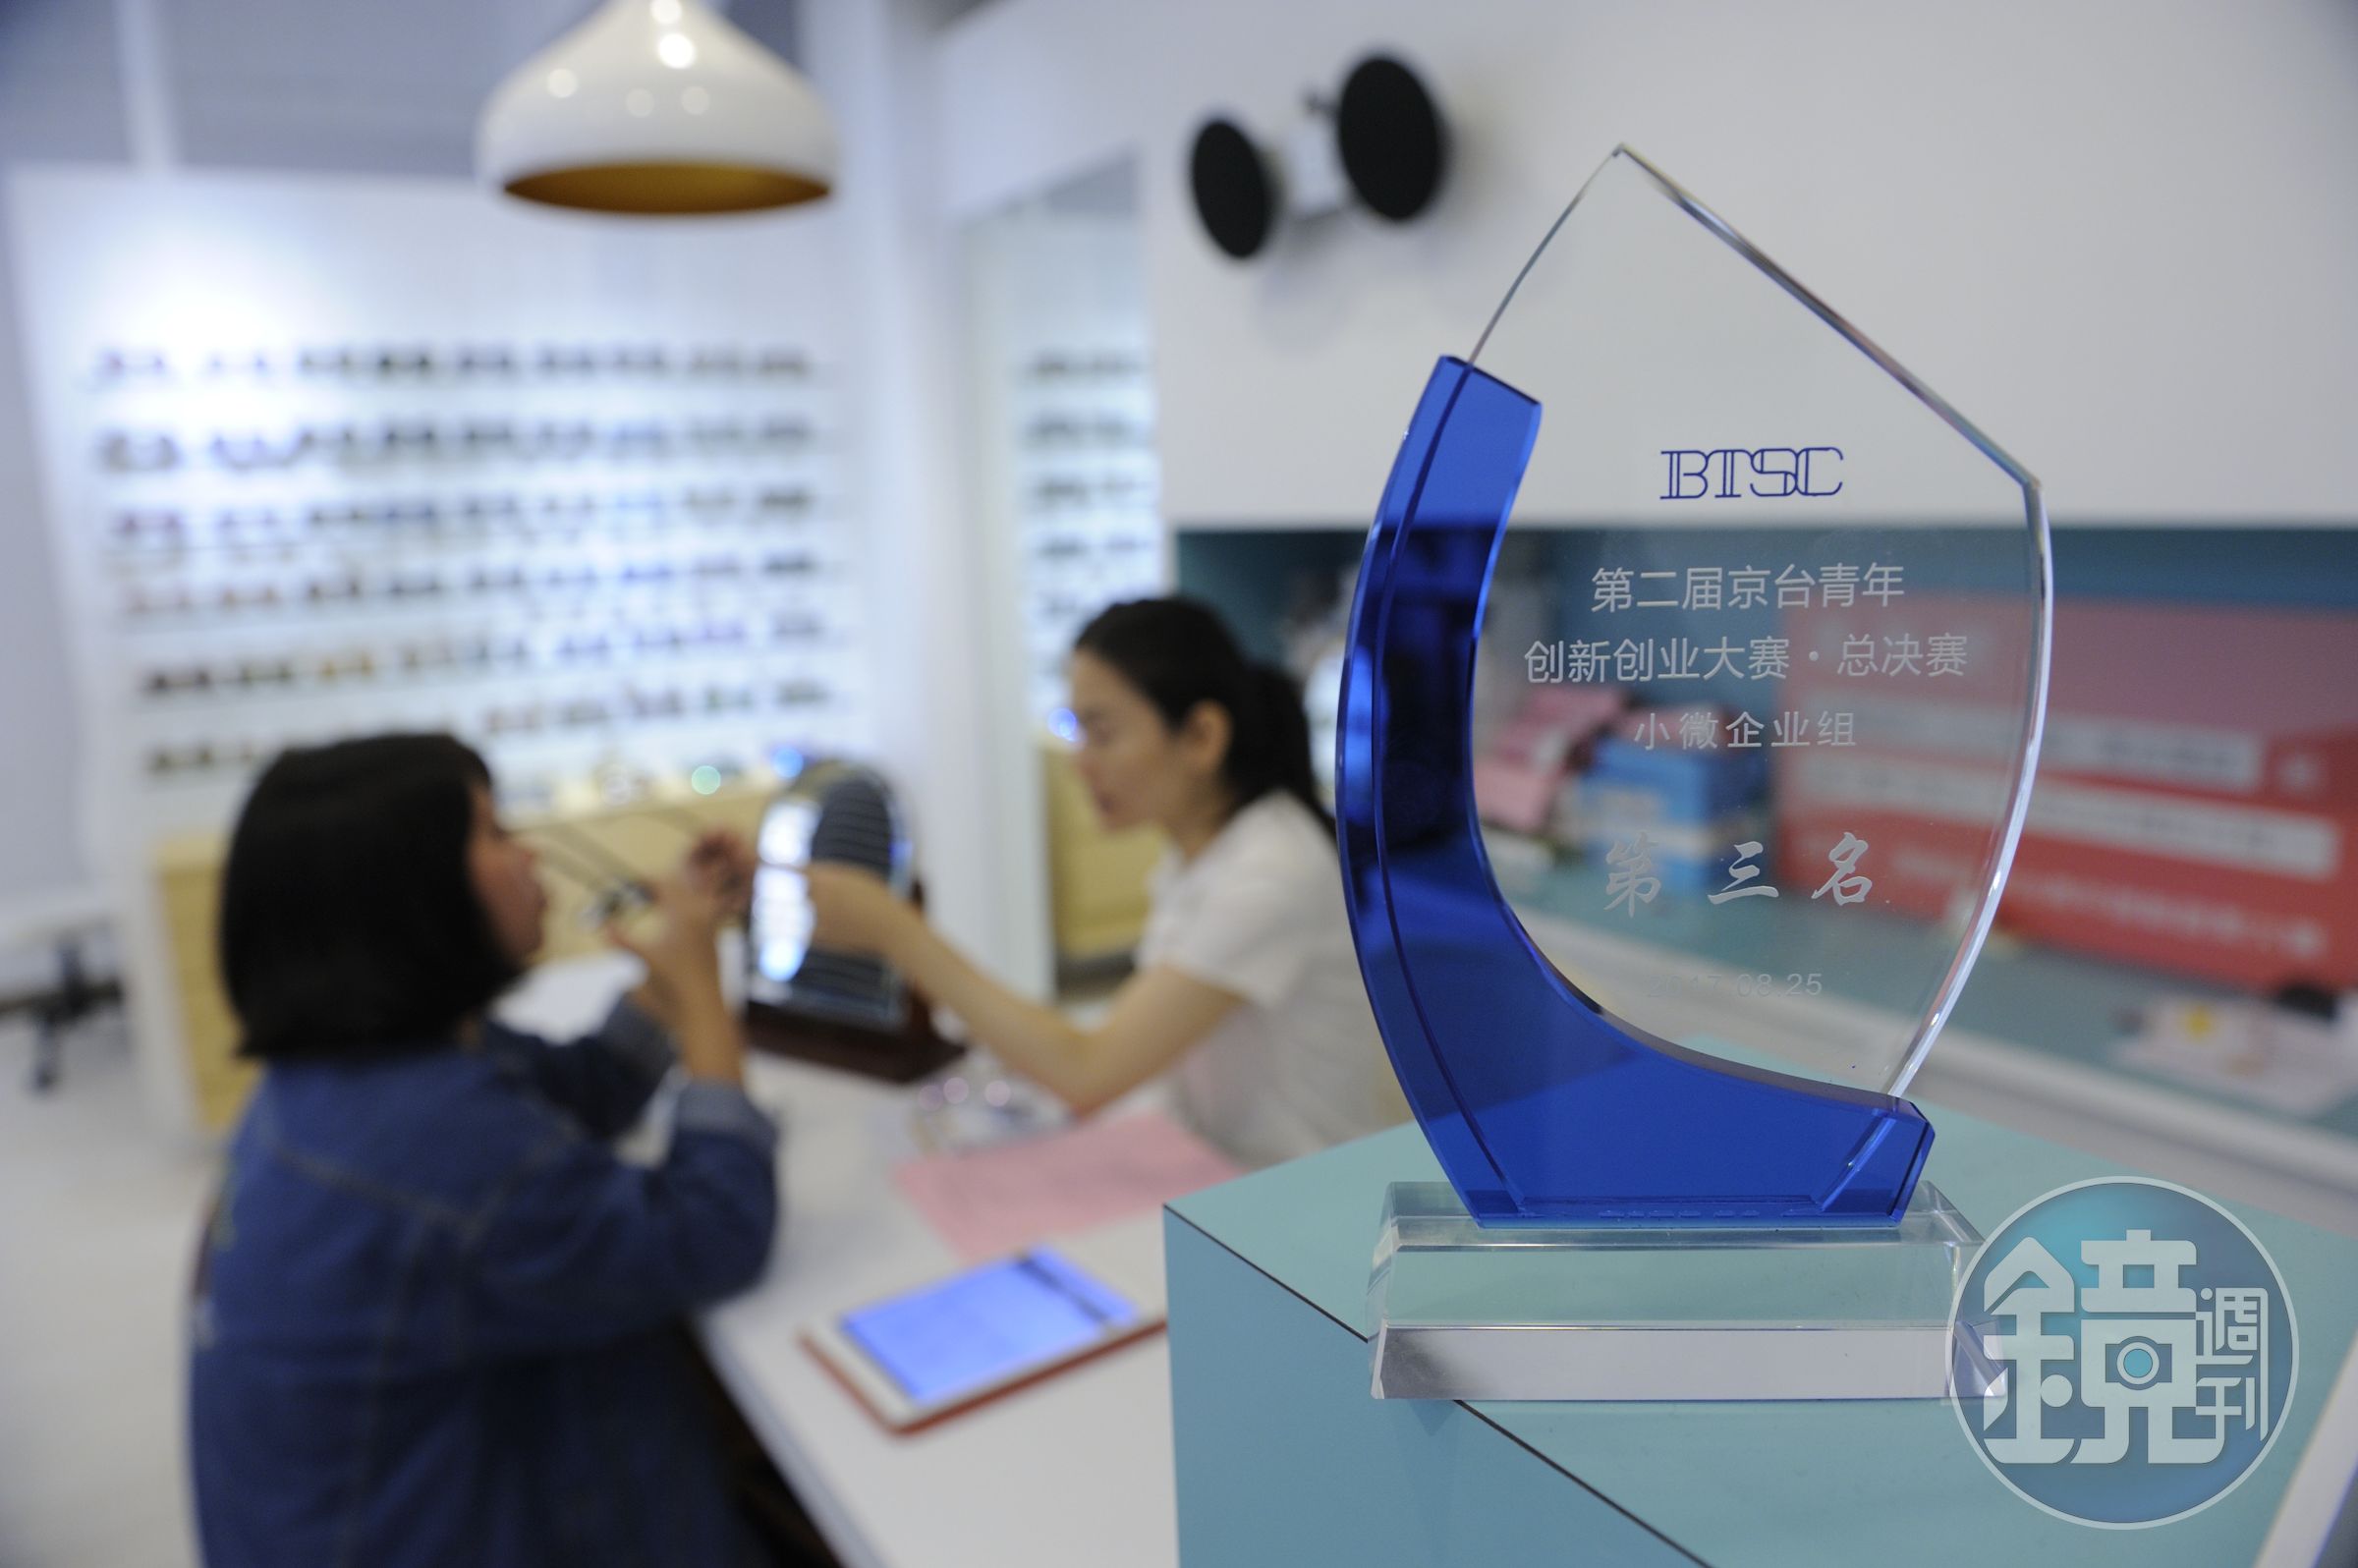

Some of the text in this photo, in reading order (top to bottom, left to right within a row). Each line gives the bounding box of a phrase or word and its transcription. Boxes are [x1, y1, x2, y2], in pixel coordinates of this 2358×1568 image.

[1660, 447, 1843, 499] BTSC
[1591, 562, 1905, 613] 第二届京台青年
[1634, 710, 1857, 751] 小微企业组
